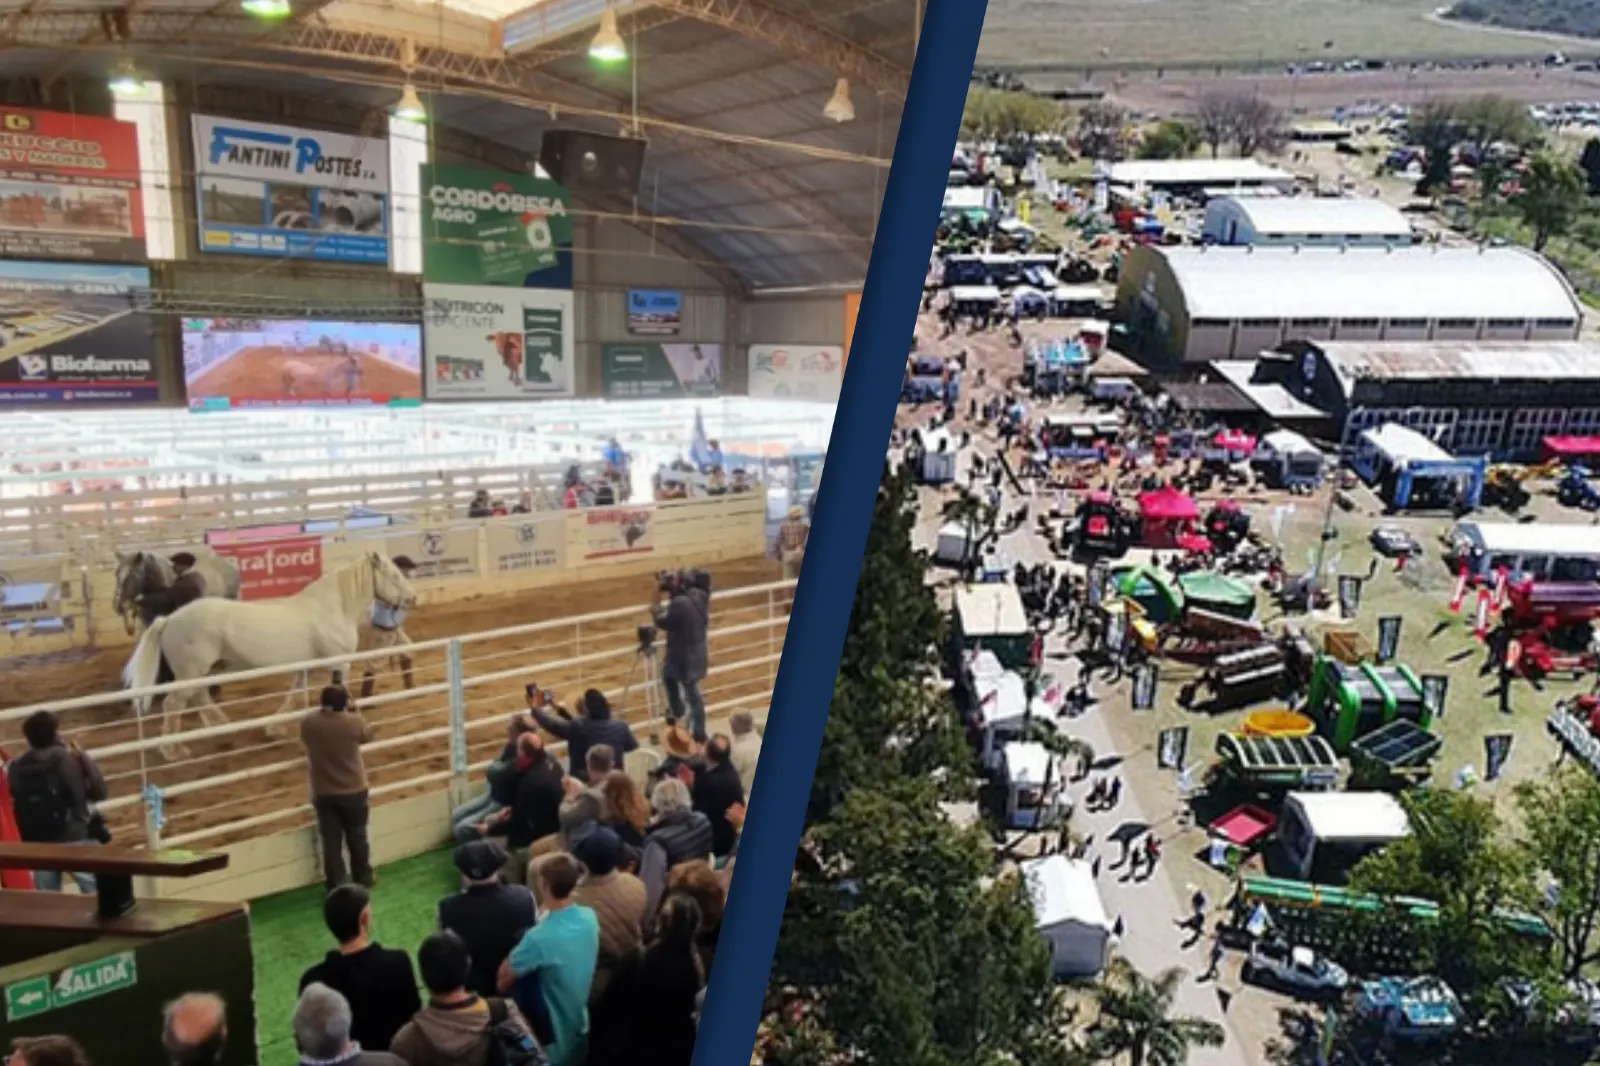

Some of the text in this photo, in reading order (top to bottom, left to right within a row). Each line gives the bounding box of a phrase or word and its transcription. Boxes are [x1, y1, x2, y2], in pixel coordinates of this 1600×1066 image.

[209, 126, 293, 169] FANTINI
[295, 137, 362, 178] POSTES
[429, 185, 567, 218] CORDOBESA
[432, 207, 477, 225] AGRO
[52, 354, 151, 372] Biofarma
[59, 957, 128, 998] SALIDA
